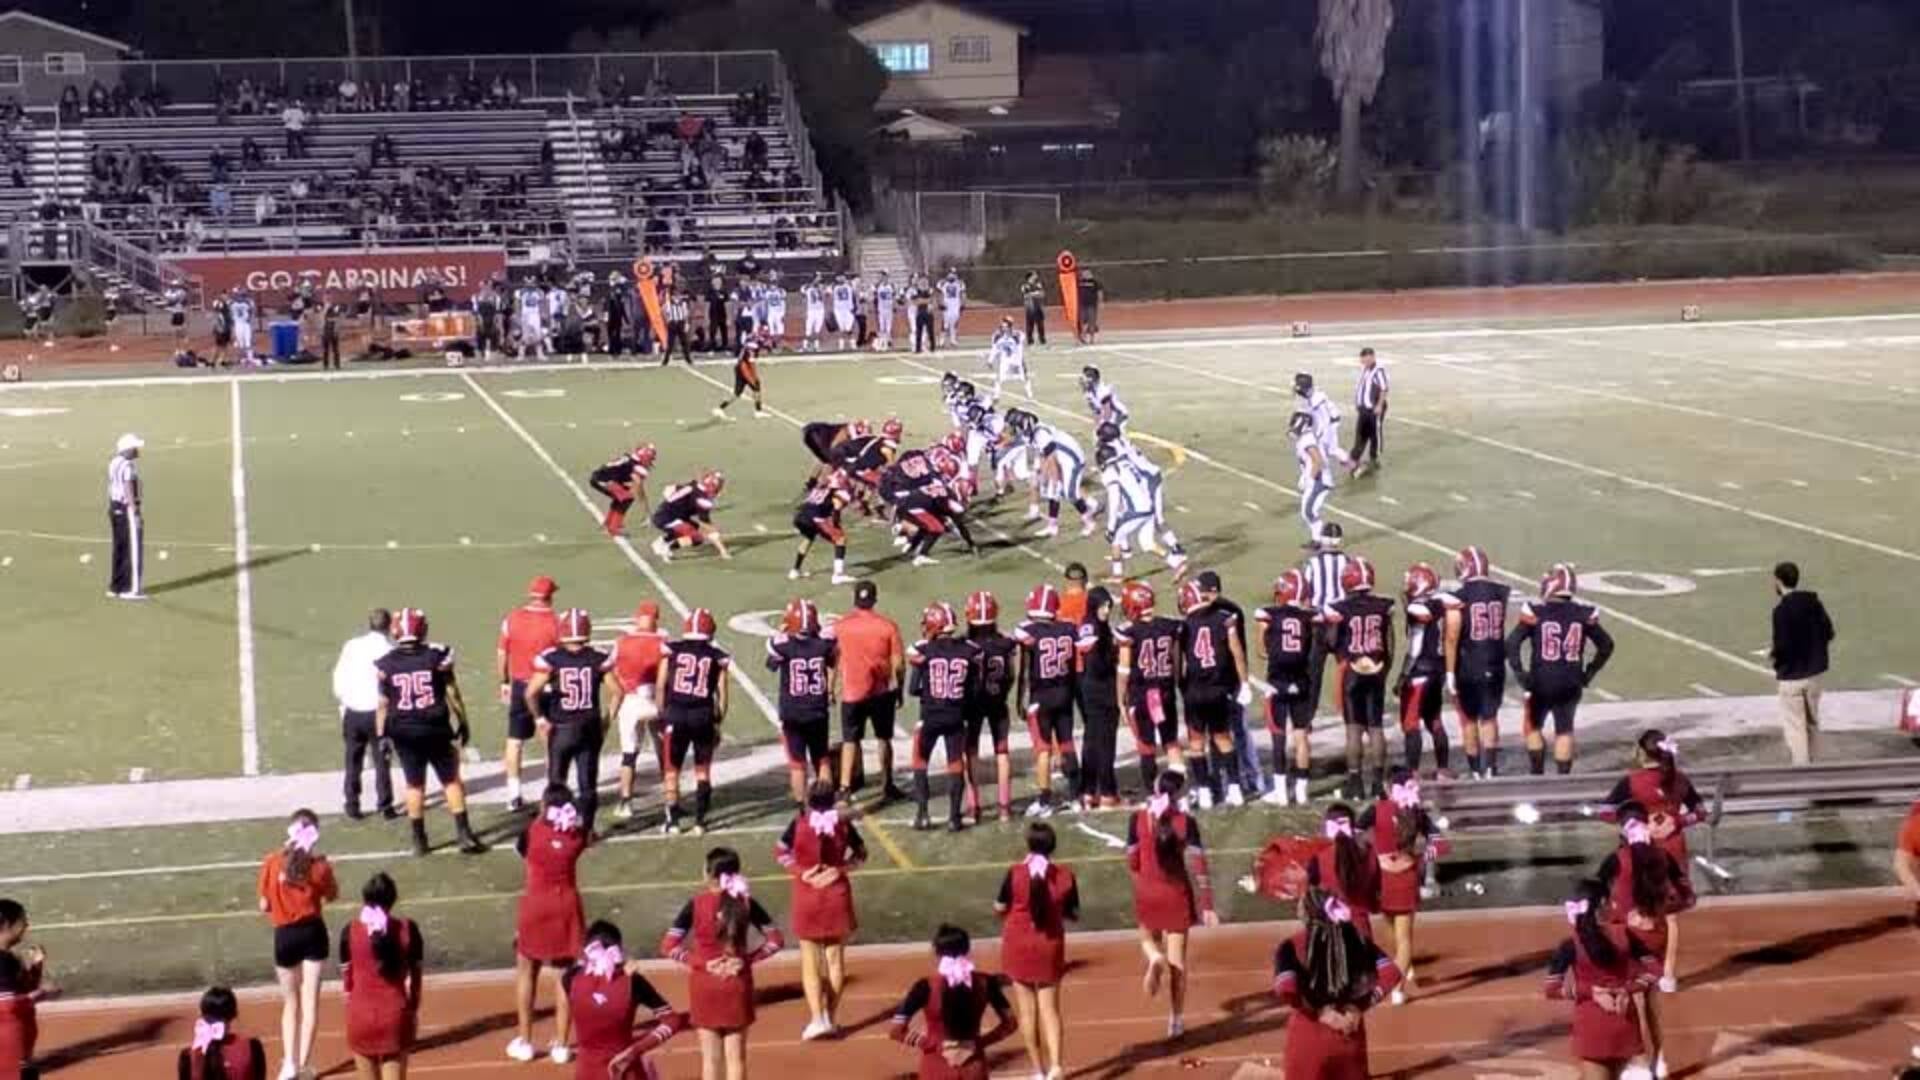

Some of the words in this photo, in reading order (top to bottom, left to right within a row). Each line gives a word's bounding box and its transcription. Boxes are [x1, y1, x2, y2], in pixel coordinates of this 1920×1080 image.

[246, 269, 293, 292] GO
[1193, 625, 1217, 669] 4
[1281, 616, 1303, 653] 2
[1540, 620, 1583, 662] 64
[672, 652, 712, 699] 21
[788, 656, 826, 696] 63
[928, 657, 969, 700] 82
[1038, 635, 1073, 679] 22
[1137, 635, 1173, 679] 42
[393, 670, 436, 711] 75
[558, 666, 593, 711] 51
